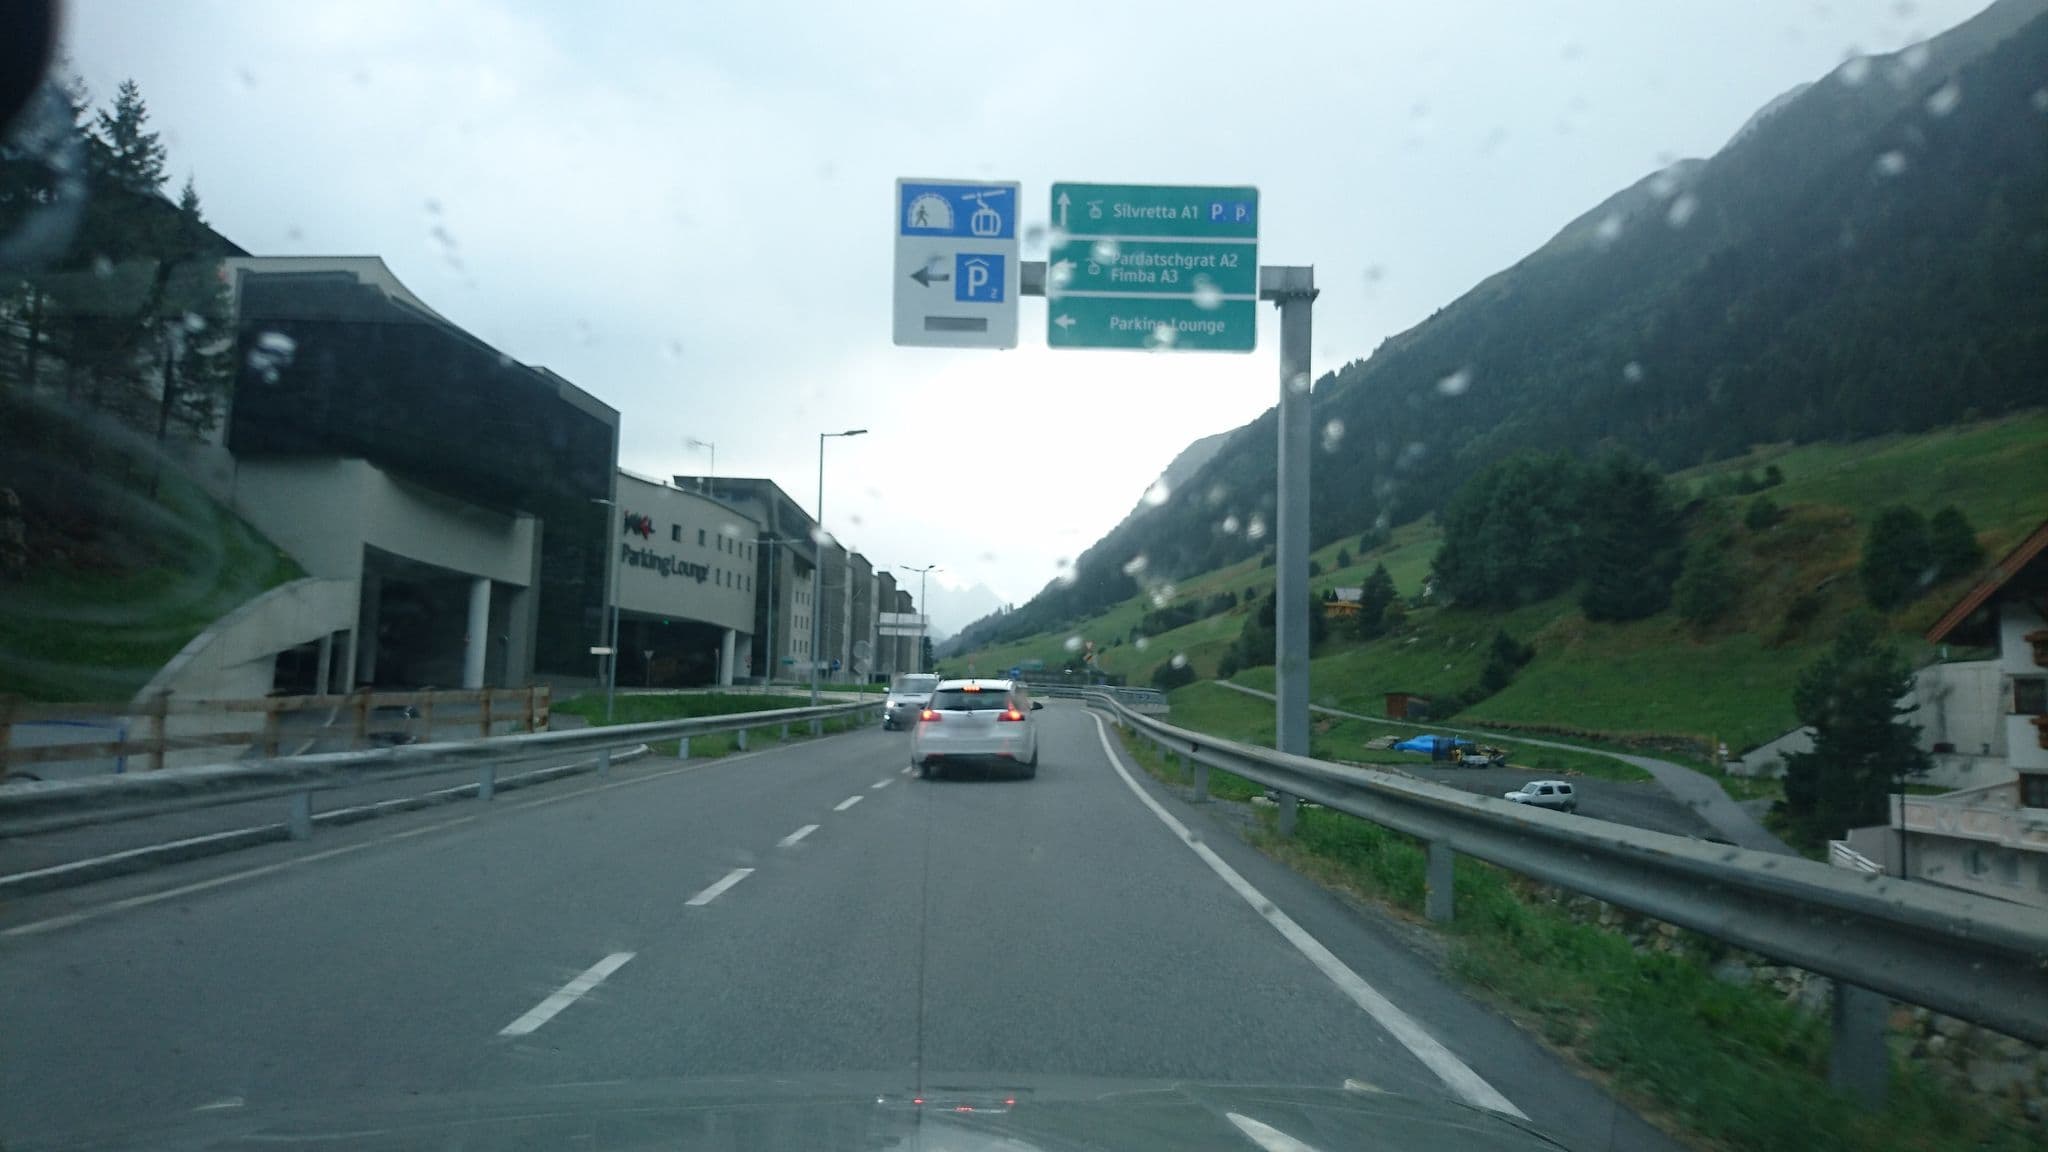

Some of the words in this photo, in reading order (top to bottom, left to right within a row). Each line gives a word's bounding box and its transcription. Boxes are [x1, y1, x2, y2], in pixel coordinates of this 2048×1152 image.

[1113, 203, 1176, 219] Silvretta
[1181, 204, 1198, 219] A1
[1212, 203, 1223, 220] P
[1236, 207, 1246, 221] P
[1111, 251, 1215, 269] Pardatschgrat
[1219, 253, 1238, 267] A2
[968, 266, 988, 297] P
[1111, 269, 1155, 283] Fimba
[1160, 270, 1178, 283] A3
[1171, 318, 1225, 335] Lounge
